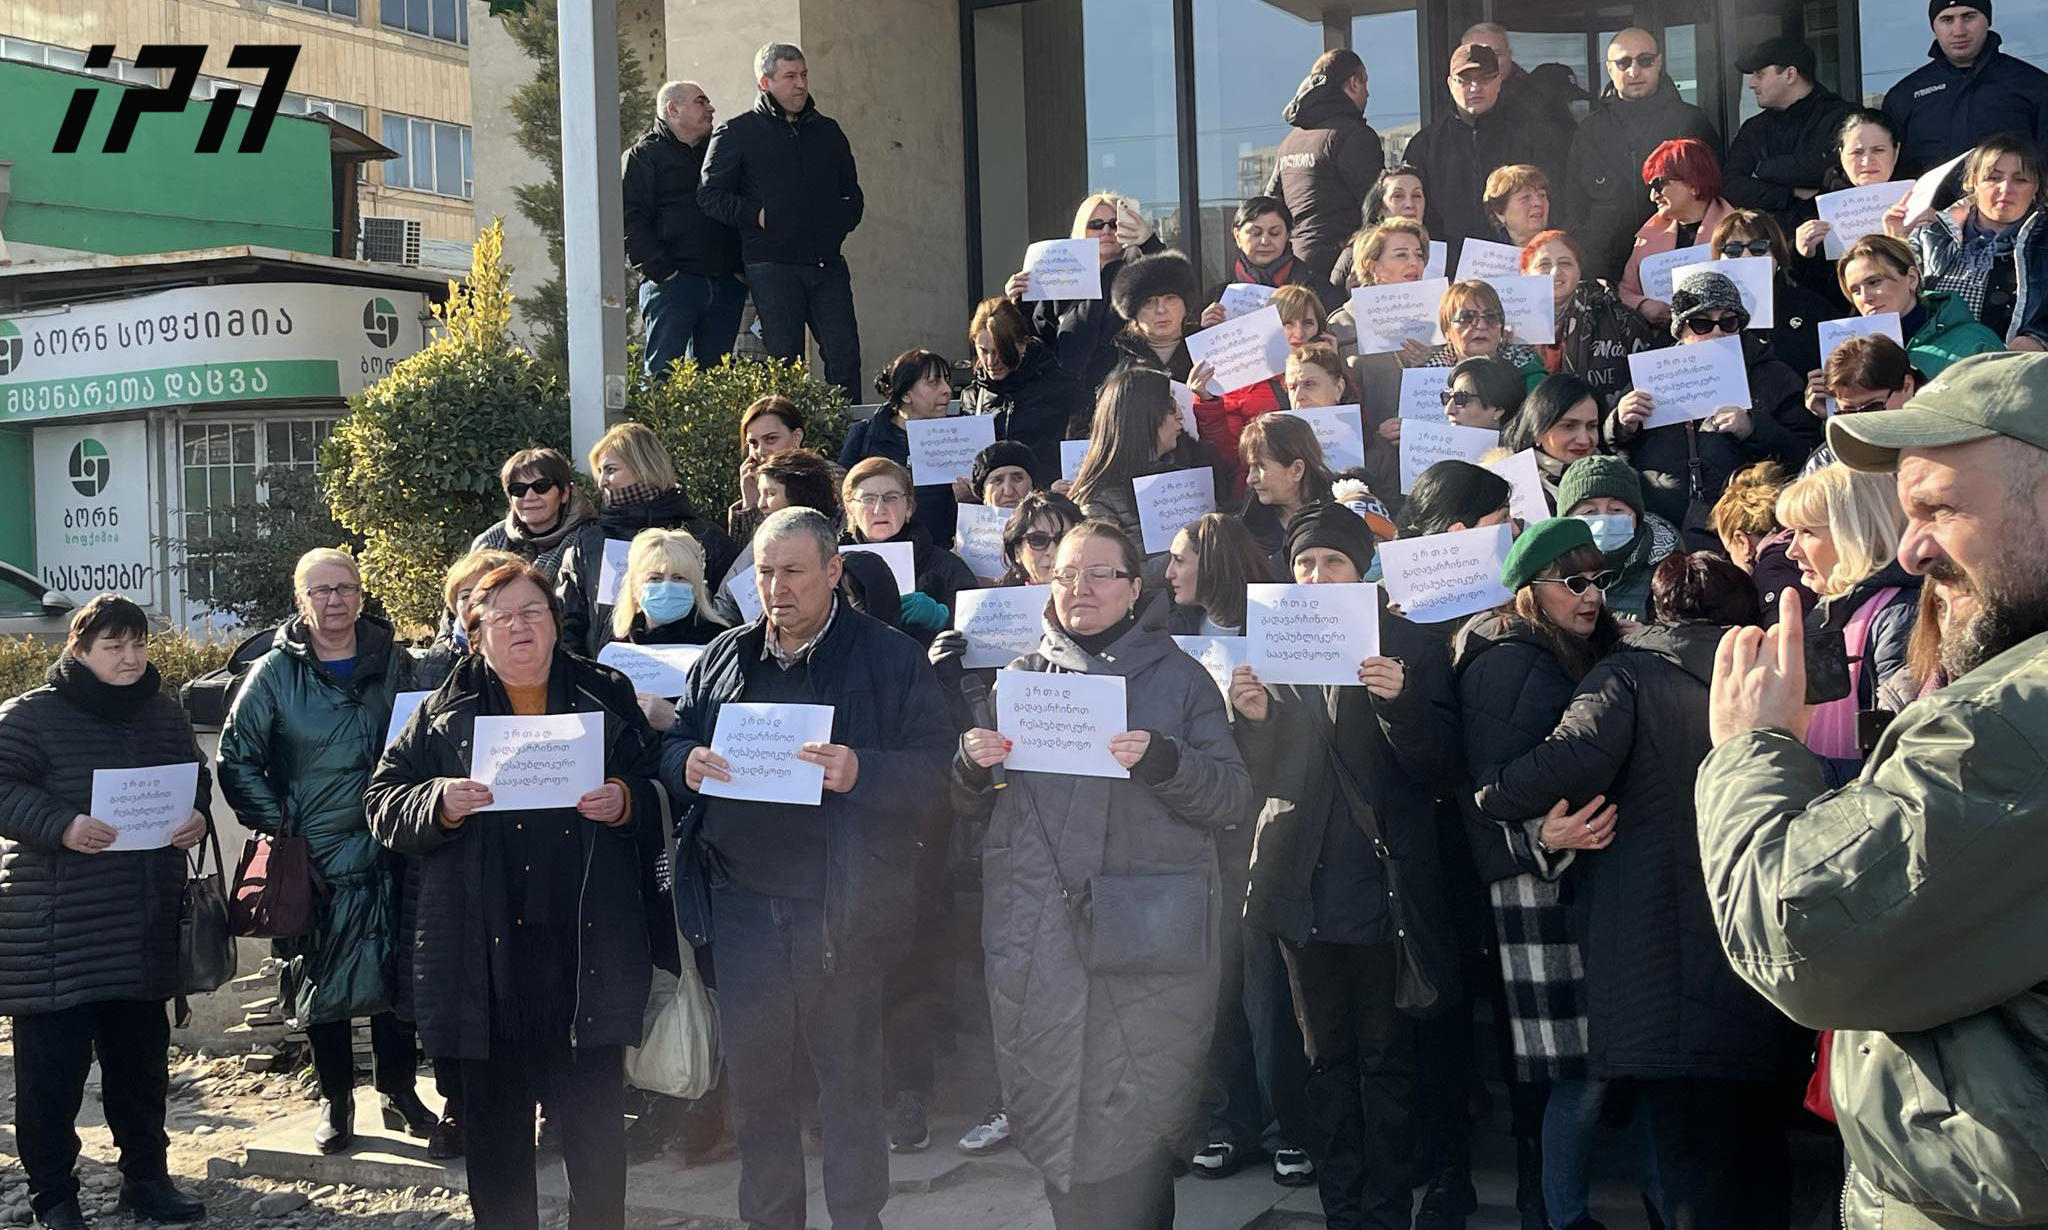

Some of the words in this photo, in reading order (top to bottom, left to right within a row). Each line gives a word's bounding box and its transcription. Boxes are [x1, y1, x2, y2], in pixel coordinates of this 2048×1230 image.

[33, 325, 108, 357] ბორნ
[118, 307, 294, 348] სოფქიმია
[360, 355, 406, 375] ბორ
[7, 377, 155, 413] მცენარეთა
[165, 367, 269, 399] დაცვა
[64, 505, 118, 528] ბორნ
[65, 534, 119, 547] სოფქიმია
[1411, 544, 1460, 562] ერთად
[1402, 557, 1480, 579] გადავარჩინოთ
[1410, 571, 1488, 593] რესპუბლიკური
[1272, 598, 1320, 609] ერთად
[1261, 614, 1339, 626] გადავარჩინოთ
[1265, 631, 1346, 644] რესპუბლიკური
[1266, 648, 1341, 661] საავადმყოფო
[1025, 686, 1071, 699] ერთად
[1014, 702, 1090, 715] გადავარჩინოთ
[740, 717, 782, 728] ერთად
[1019, 718, 1097, 733] რესპუბლიკური
[1020, 735, 1092, 750] საავადმყოფო
